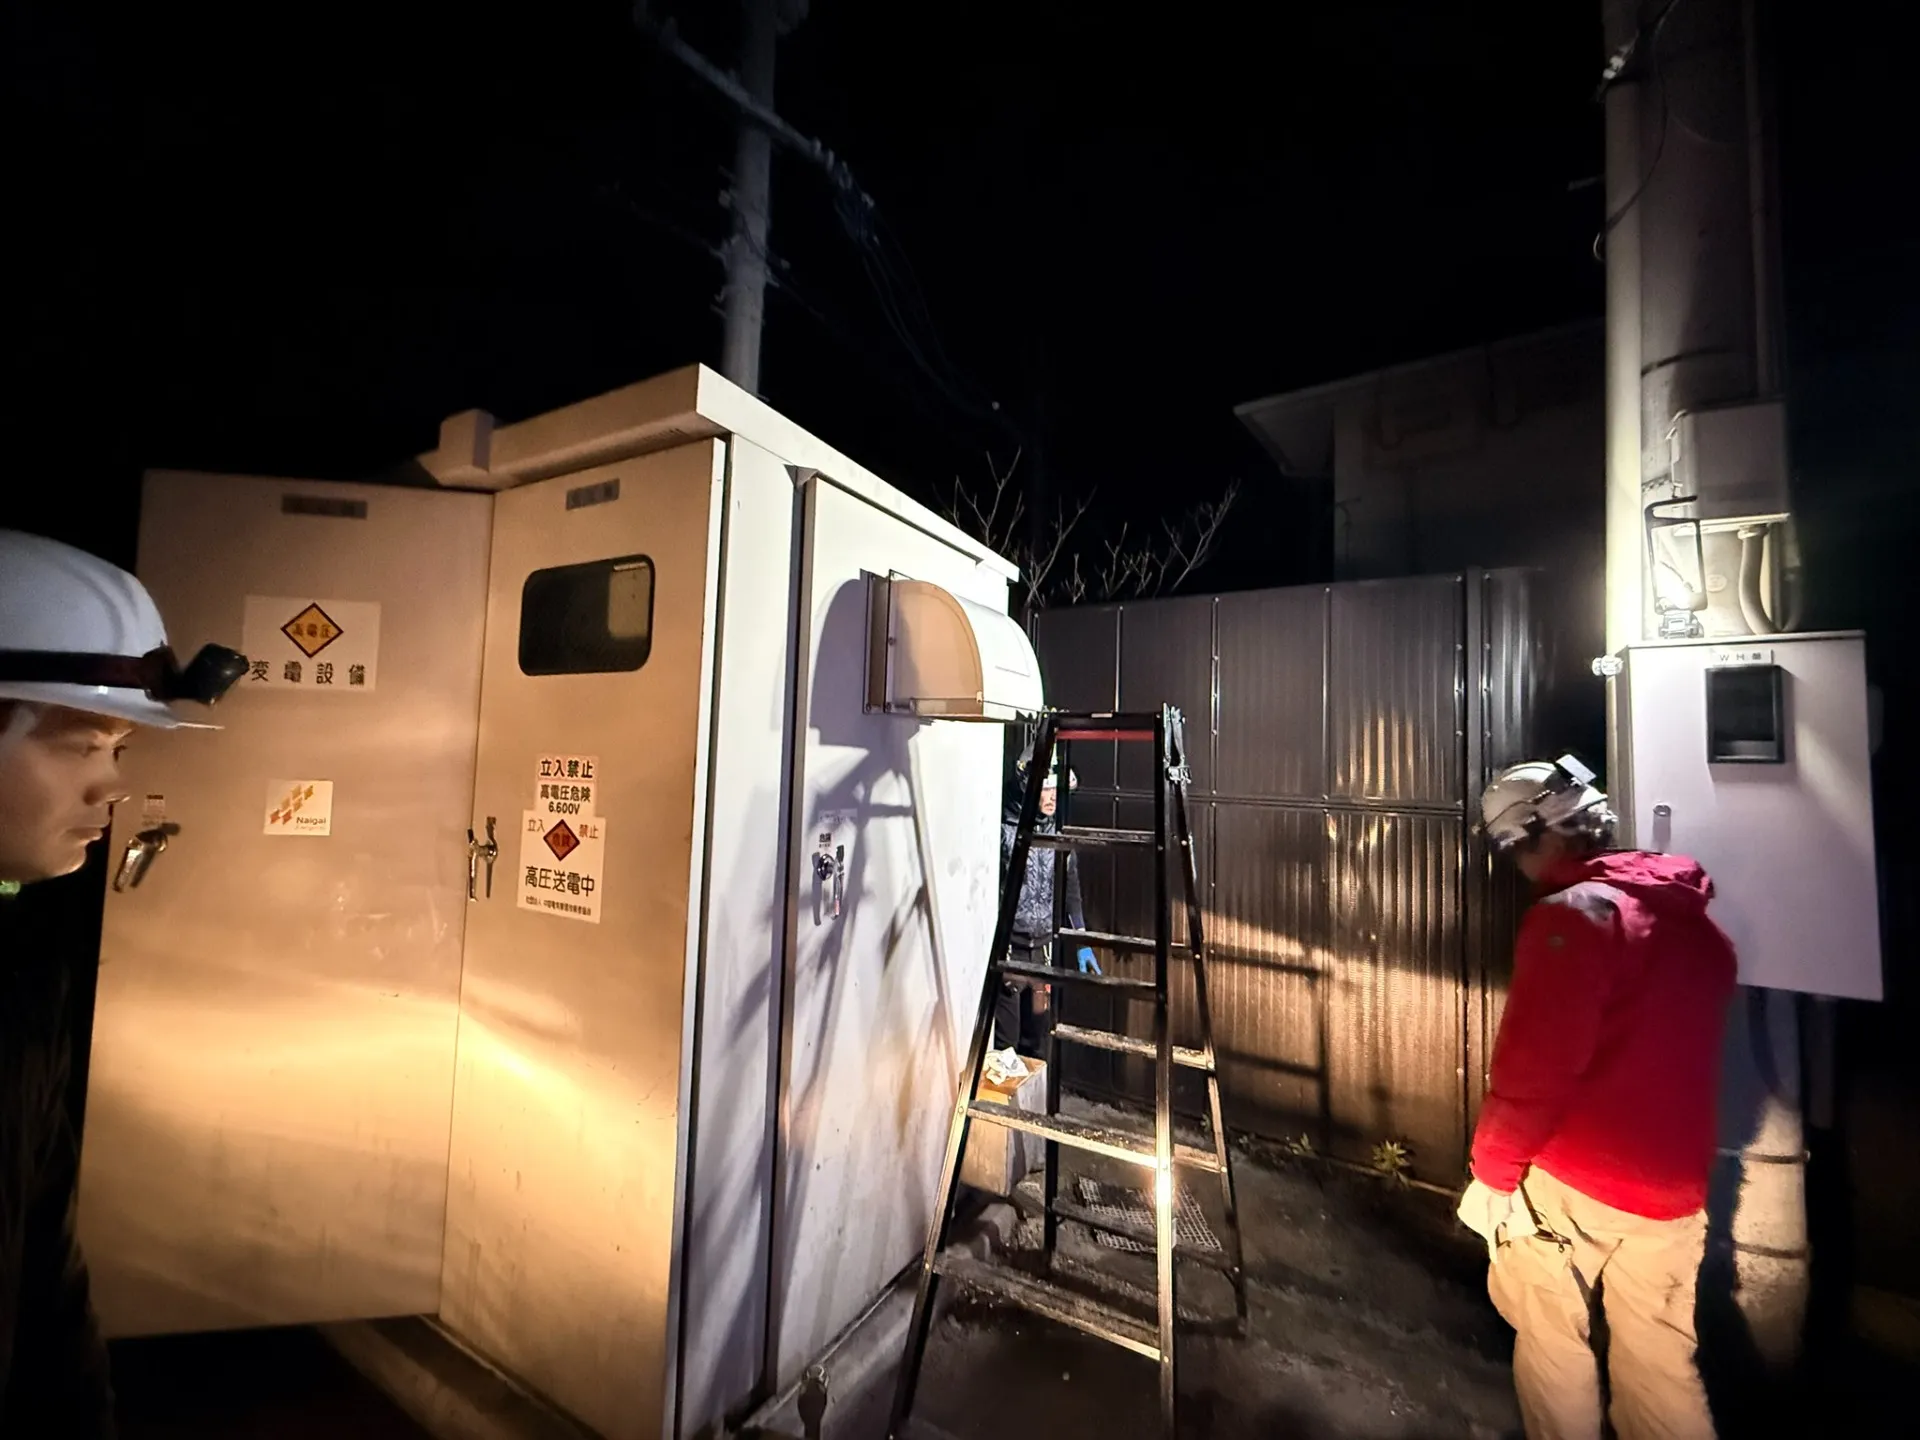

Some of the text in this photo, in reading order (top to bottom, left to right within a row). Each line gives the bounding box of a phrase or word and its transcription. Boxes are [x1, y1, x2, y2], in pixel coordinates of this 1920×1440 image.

[251, 660, 366, 686] 変電設備
[540, 758, 593, 778] 立入禁止
[540, 784, 591, 802] 高電圧危険
[296, 816, 327, 826] Naigai
[527, 818, 545, 833] 立入
[525, 866, 595, 897] 高圧送電中
